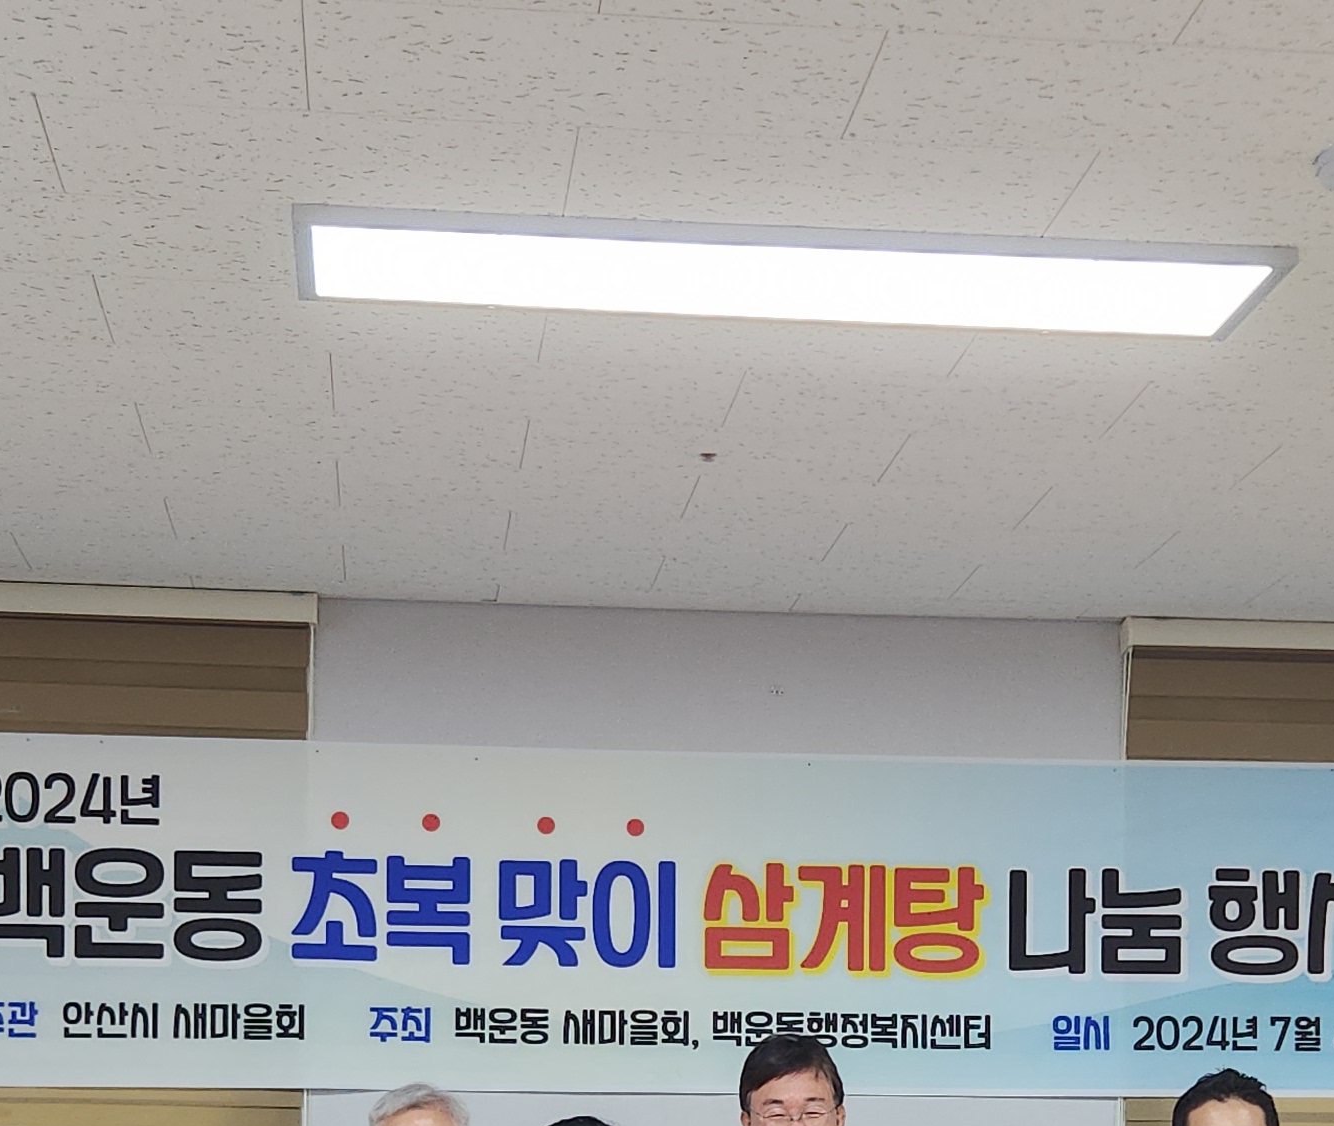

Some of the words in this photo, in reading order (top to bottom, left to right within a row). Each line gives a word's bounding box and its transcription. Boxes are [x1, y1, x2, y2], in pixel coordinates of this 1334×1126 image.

[292, 851, 472, 965] 초복
[499, 860, 677, 969] 맞이
[703, 862, 986, 975] 삼계탕
[1009, 868, 1183, 976] 나눔
[63, 1002, 159, 1040] 안산시
[174, 1003, 306, 1041] 새마을회
[370, 1007, 432, 1044] 주최
[455, 1008, 550, 1046] 백운동
[564, 1010, 700, 1051] 새마을회,
[713, 1011, 992, 1050] 백운동행정복지센터
[1053, 1016, 1111, 1052] 일시
[1133, 1016, 1259, 1052] 2024년
[1270, 1017, 1322, 1053] 7월
